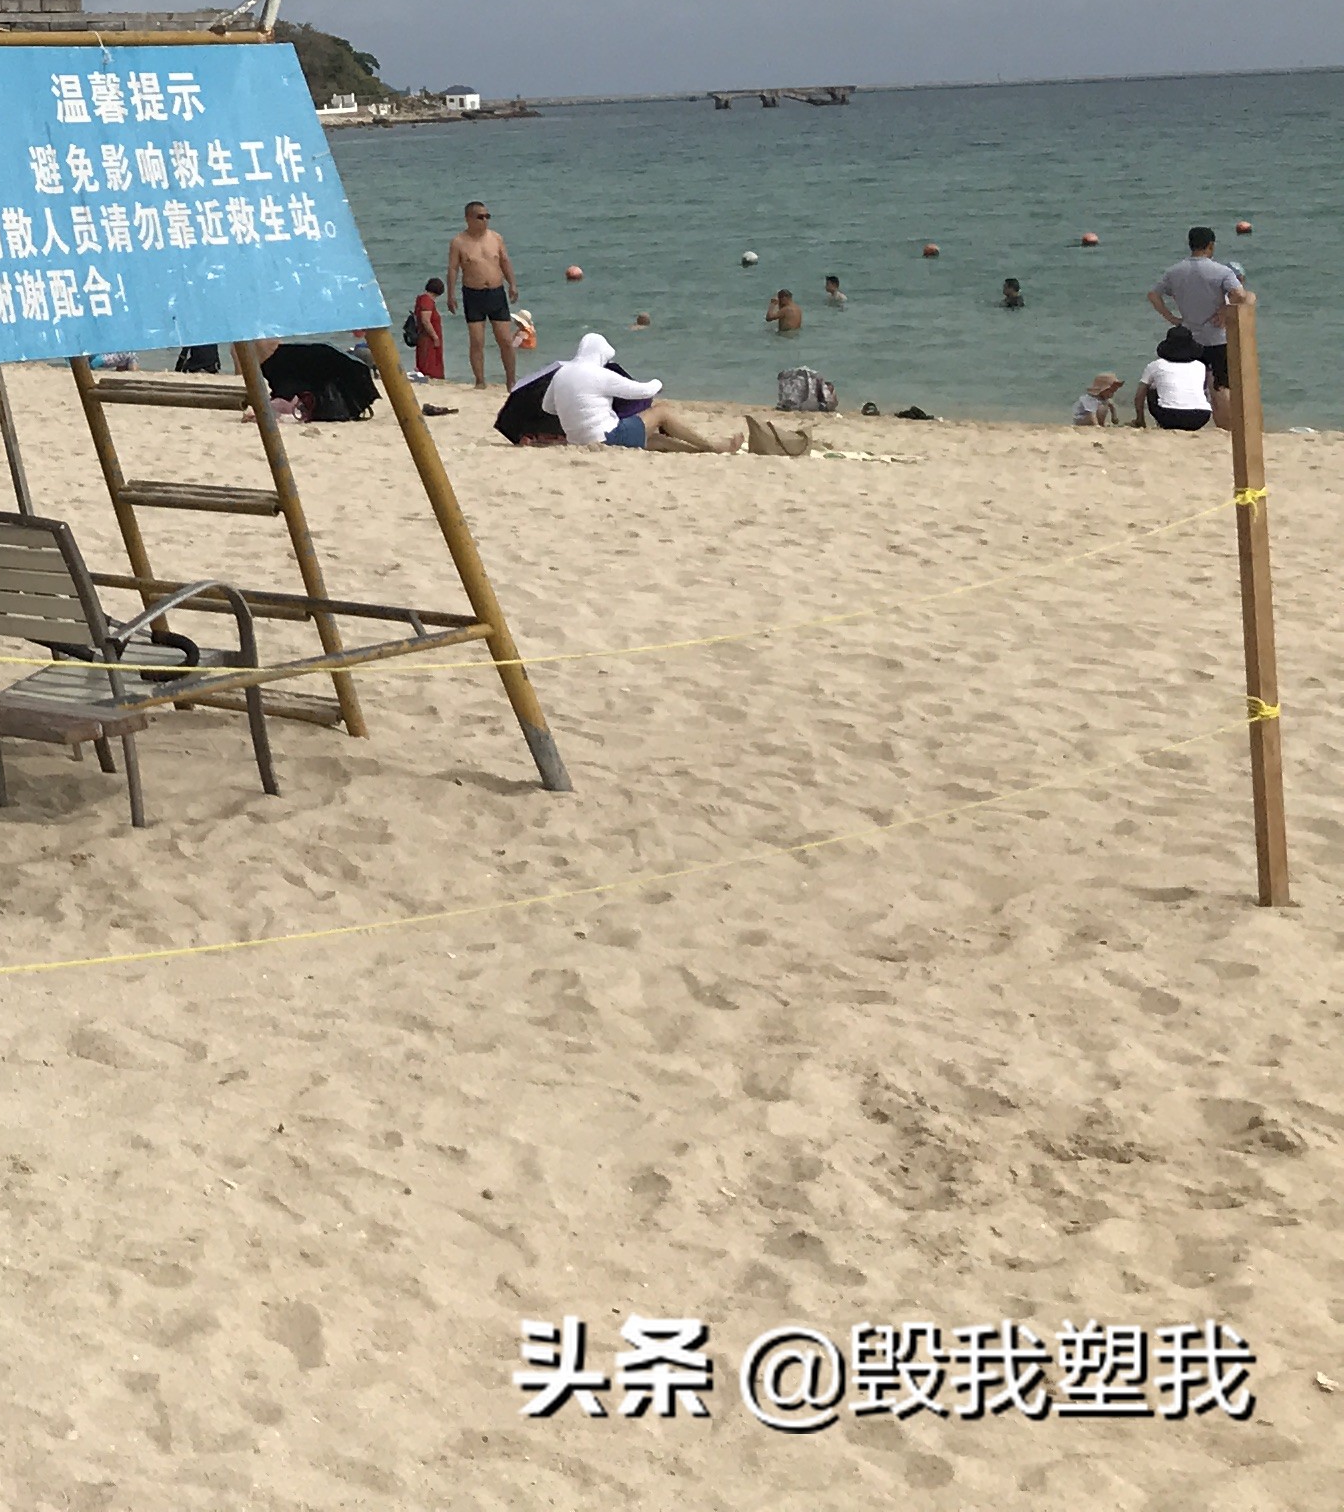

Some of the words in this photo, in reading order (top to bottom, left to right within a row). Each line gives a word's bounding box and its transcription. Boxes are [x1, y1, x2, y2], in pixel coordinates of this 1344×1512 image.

[51, 72, 206, 124] 温馨提示
[29, 135, 324, 194] 避免影响救生工作，
